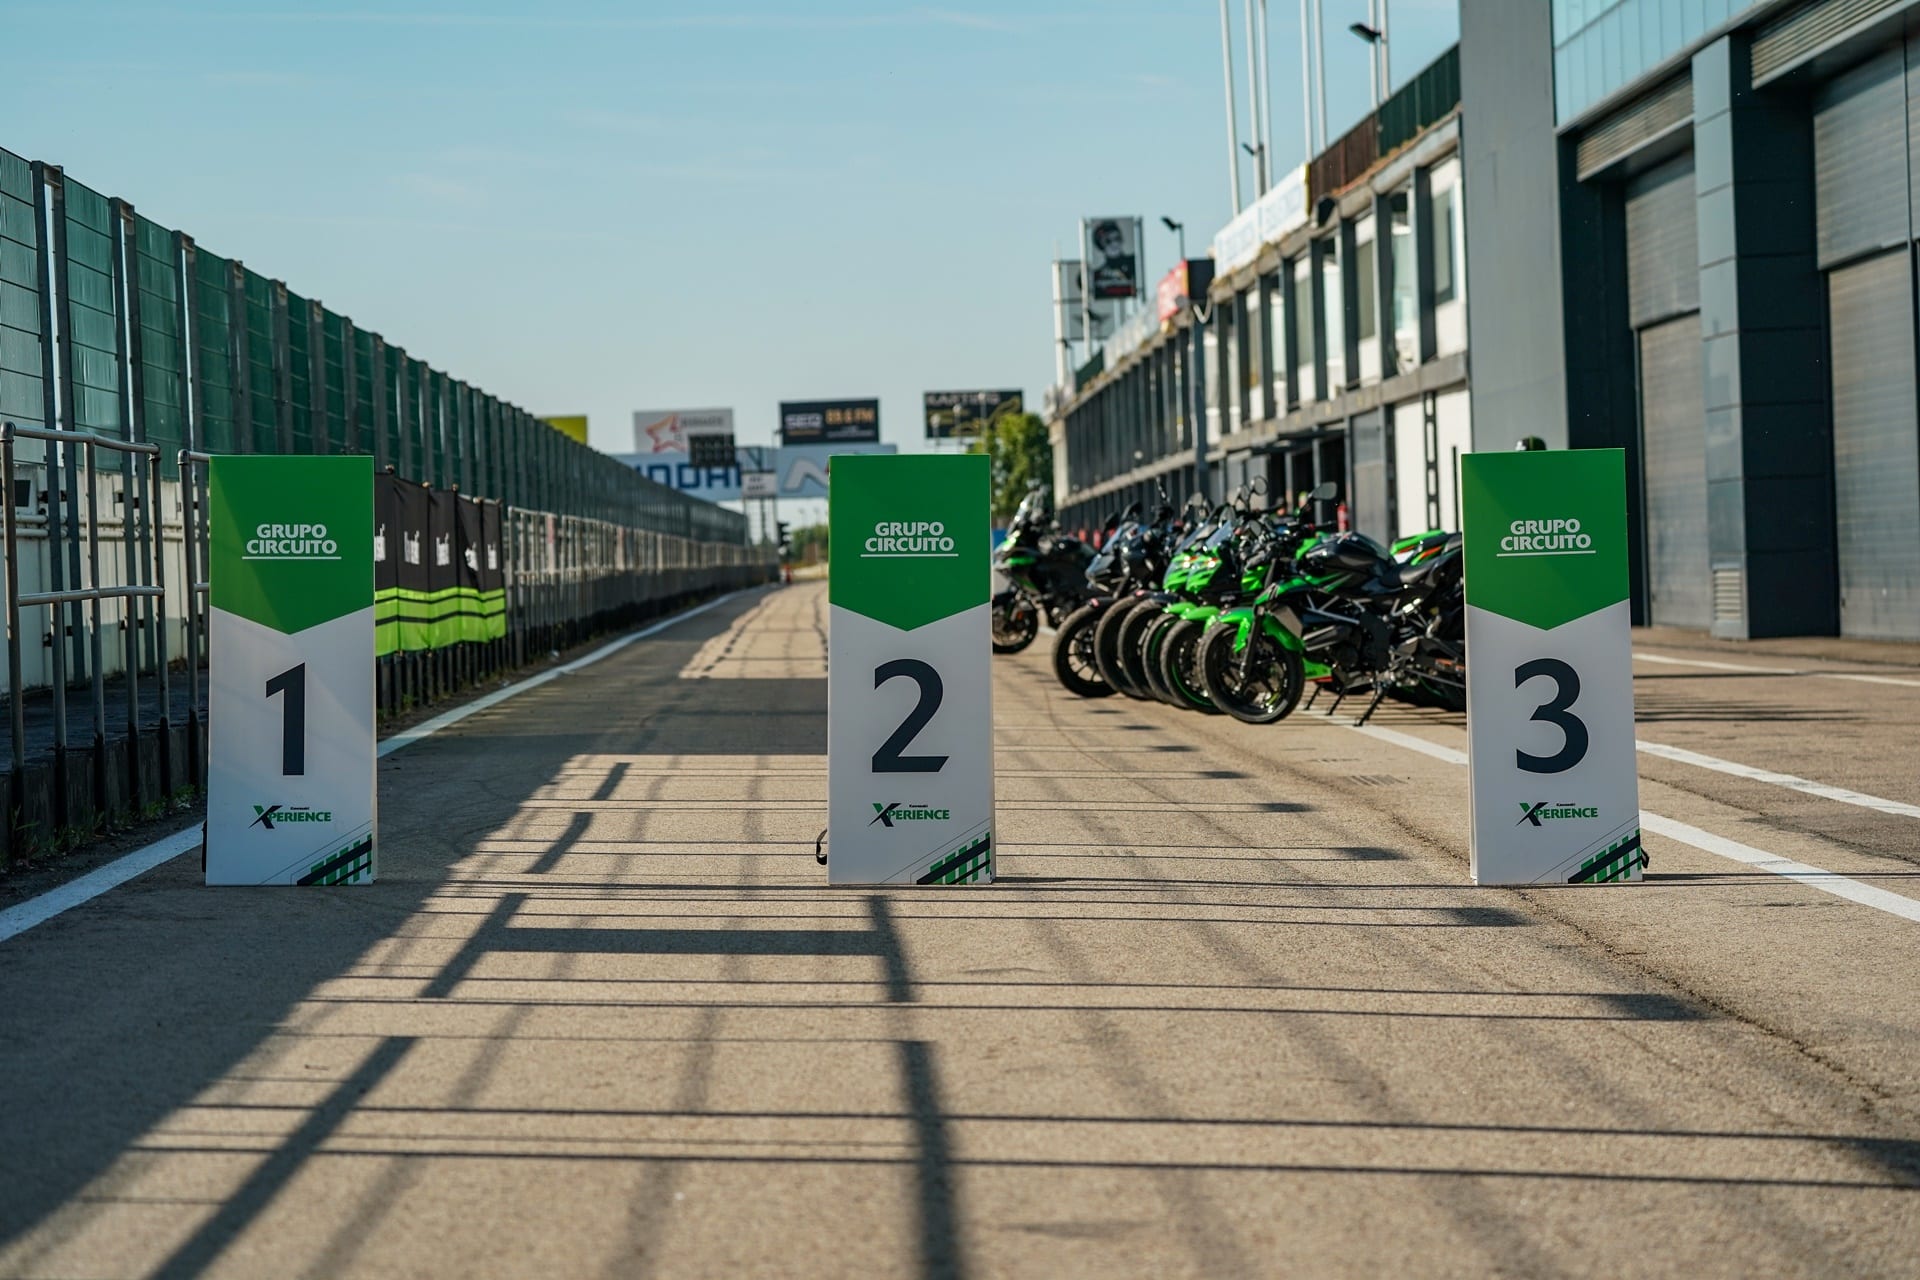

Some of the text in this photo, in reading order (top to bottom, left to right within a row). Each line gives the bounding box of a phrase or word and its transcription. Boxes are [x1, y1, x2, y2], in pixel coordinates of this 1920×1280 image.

[256, 524, 327, 539] GRUPO
[874, 521, 945, 536] GRUPO
[1510, 518, 1581, 535] GRUPO
[246, 539, 338, 554] CIRCUITO
[864, 537, 955, 552] CIRCUITO
[1500, 533, 1592, 551] CIRCUITO
[266, 662, 306, 776] 1
[871, 658, 949, 773] 2
[1514, 657, 1589, 774] 3
[248, 805, 332, 829] XPERIENCE
[868, 803, 950, 827] XPERIENCE
[1515, 802, 1598, 826] XPERIENCE
